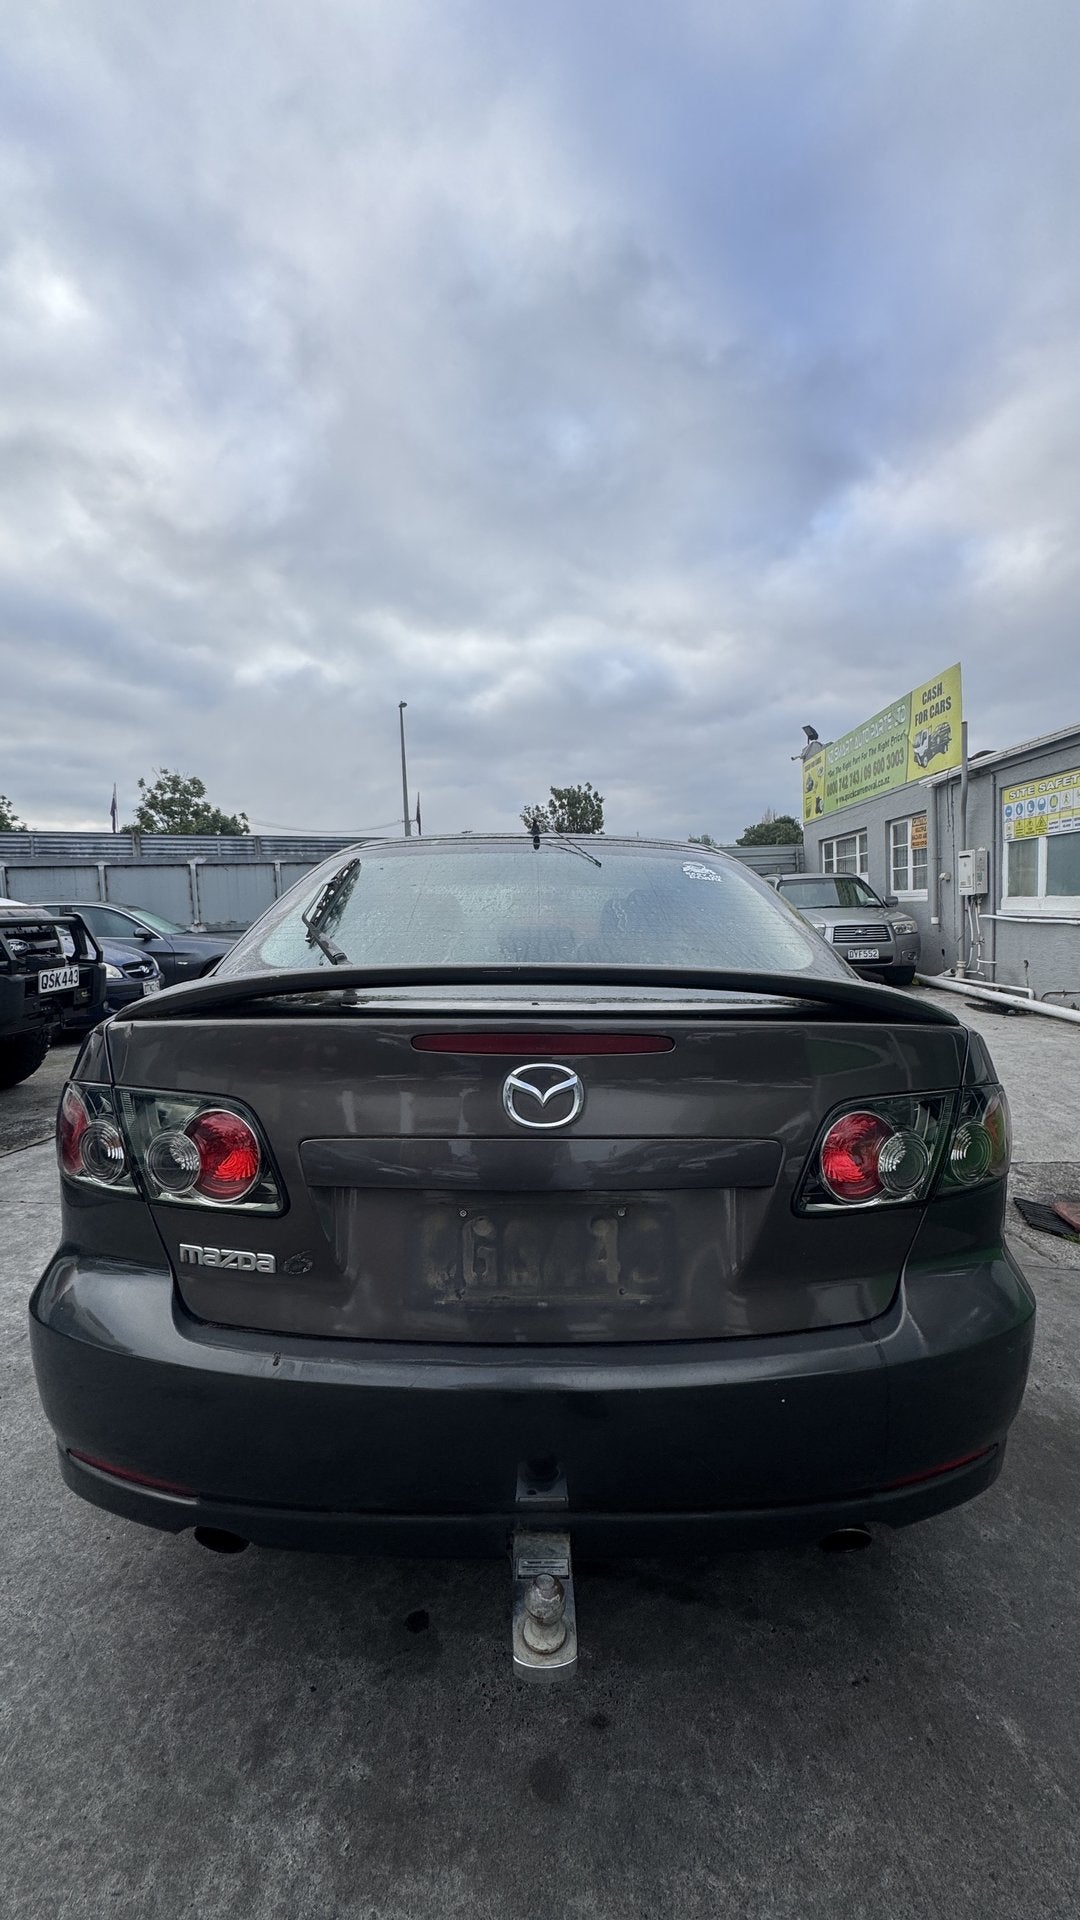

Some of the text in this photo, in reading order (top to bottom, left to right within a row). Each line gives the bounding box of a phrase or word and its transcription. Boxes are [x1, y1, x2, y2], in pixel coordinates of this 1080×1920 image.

[922, 682, 943, 705] CASH
[915, 696, 952, 727] FOR CARS
[854, 727, 869, 749] AUTO
[878, 738, 888, 752] Right
[838, 774, 848, 792] 742
[849, 768, 859, 787] 743
[863, 763, 871, 780] 09
[872, 756, 885, 776] 600
[886, 747, 904, 770] 3003
[1009, 785, 1035, 800] SITE
[41, 969, 79, 990] QSK443
